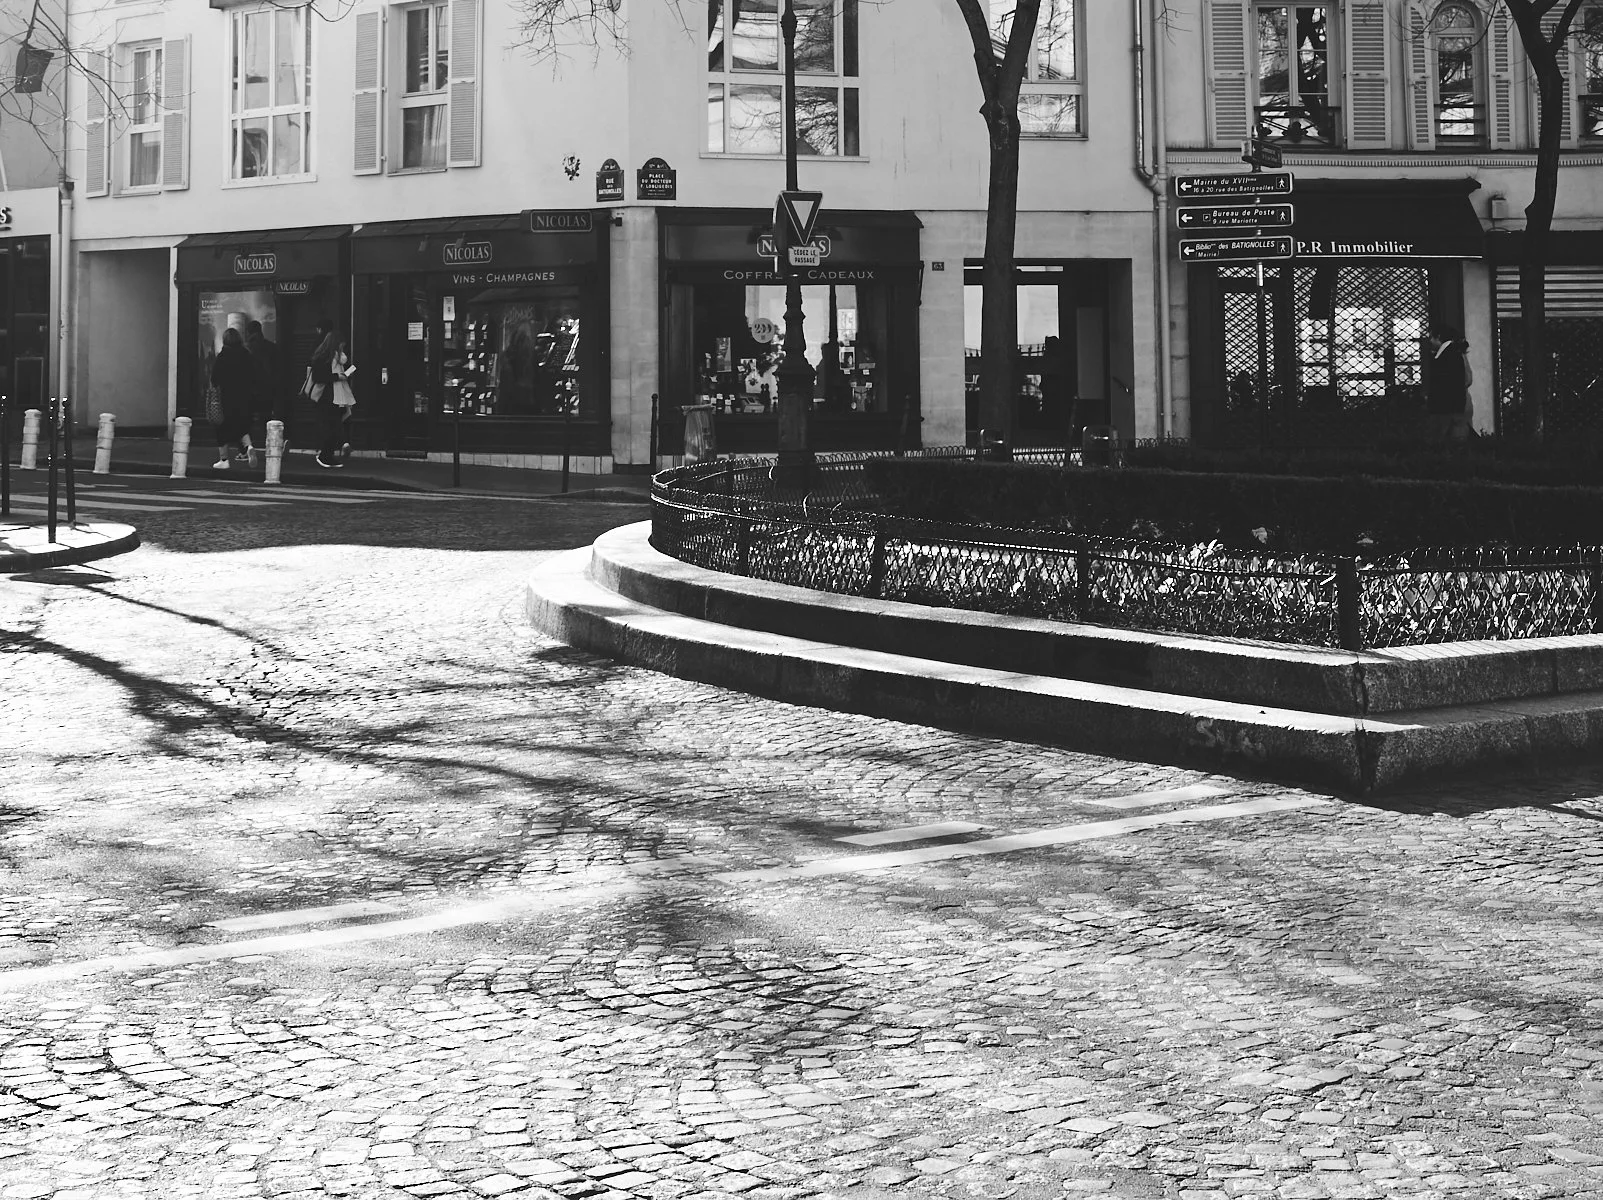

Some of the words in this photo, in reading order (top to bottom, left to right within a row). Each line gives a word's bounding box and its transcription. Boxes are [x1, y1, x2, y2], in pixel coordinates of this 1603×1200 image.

[536, 215, 587, 227] NICOLAS
[1232, 240, 1275, 248] BATIGNOLLES
[1297, 242, 1322, 253] P.R
[1330, 241, 1413, 253] Immobilier
[446, 247, 489, 260] NICOLAS
[237, 258, 274, 270] NICOLAS
[486, 272, 555, 283] CHAMPAGNES
[808, 270, 874, 279] CADEAUX
[279, 282, 307, 291] NICOLAS
